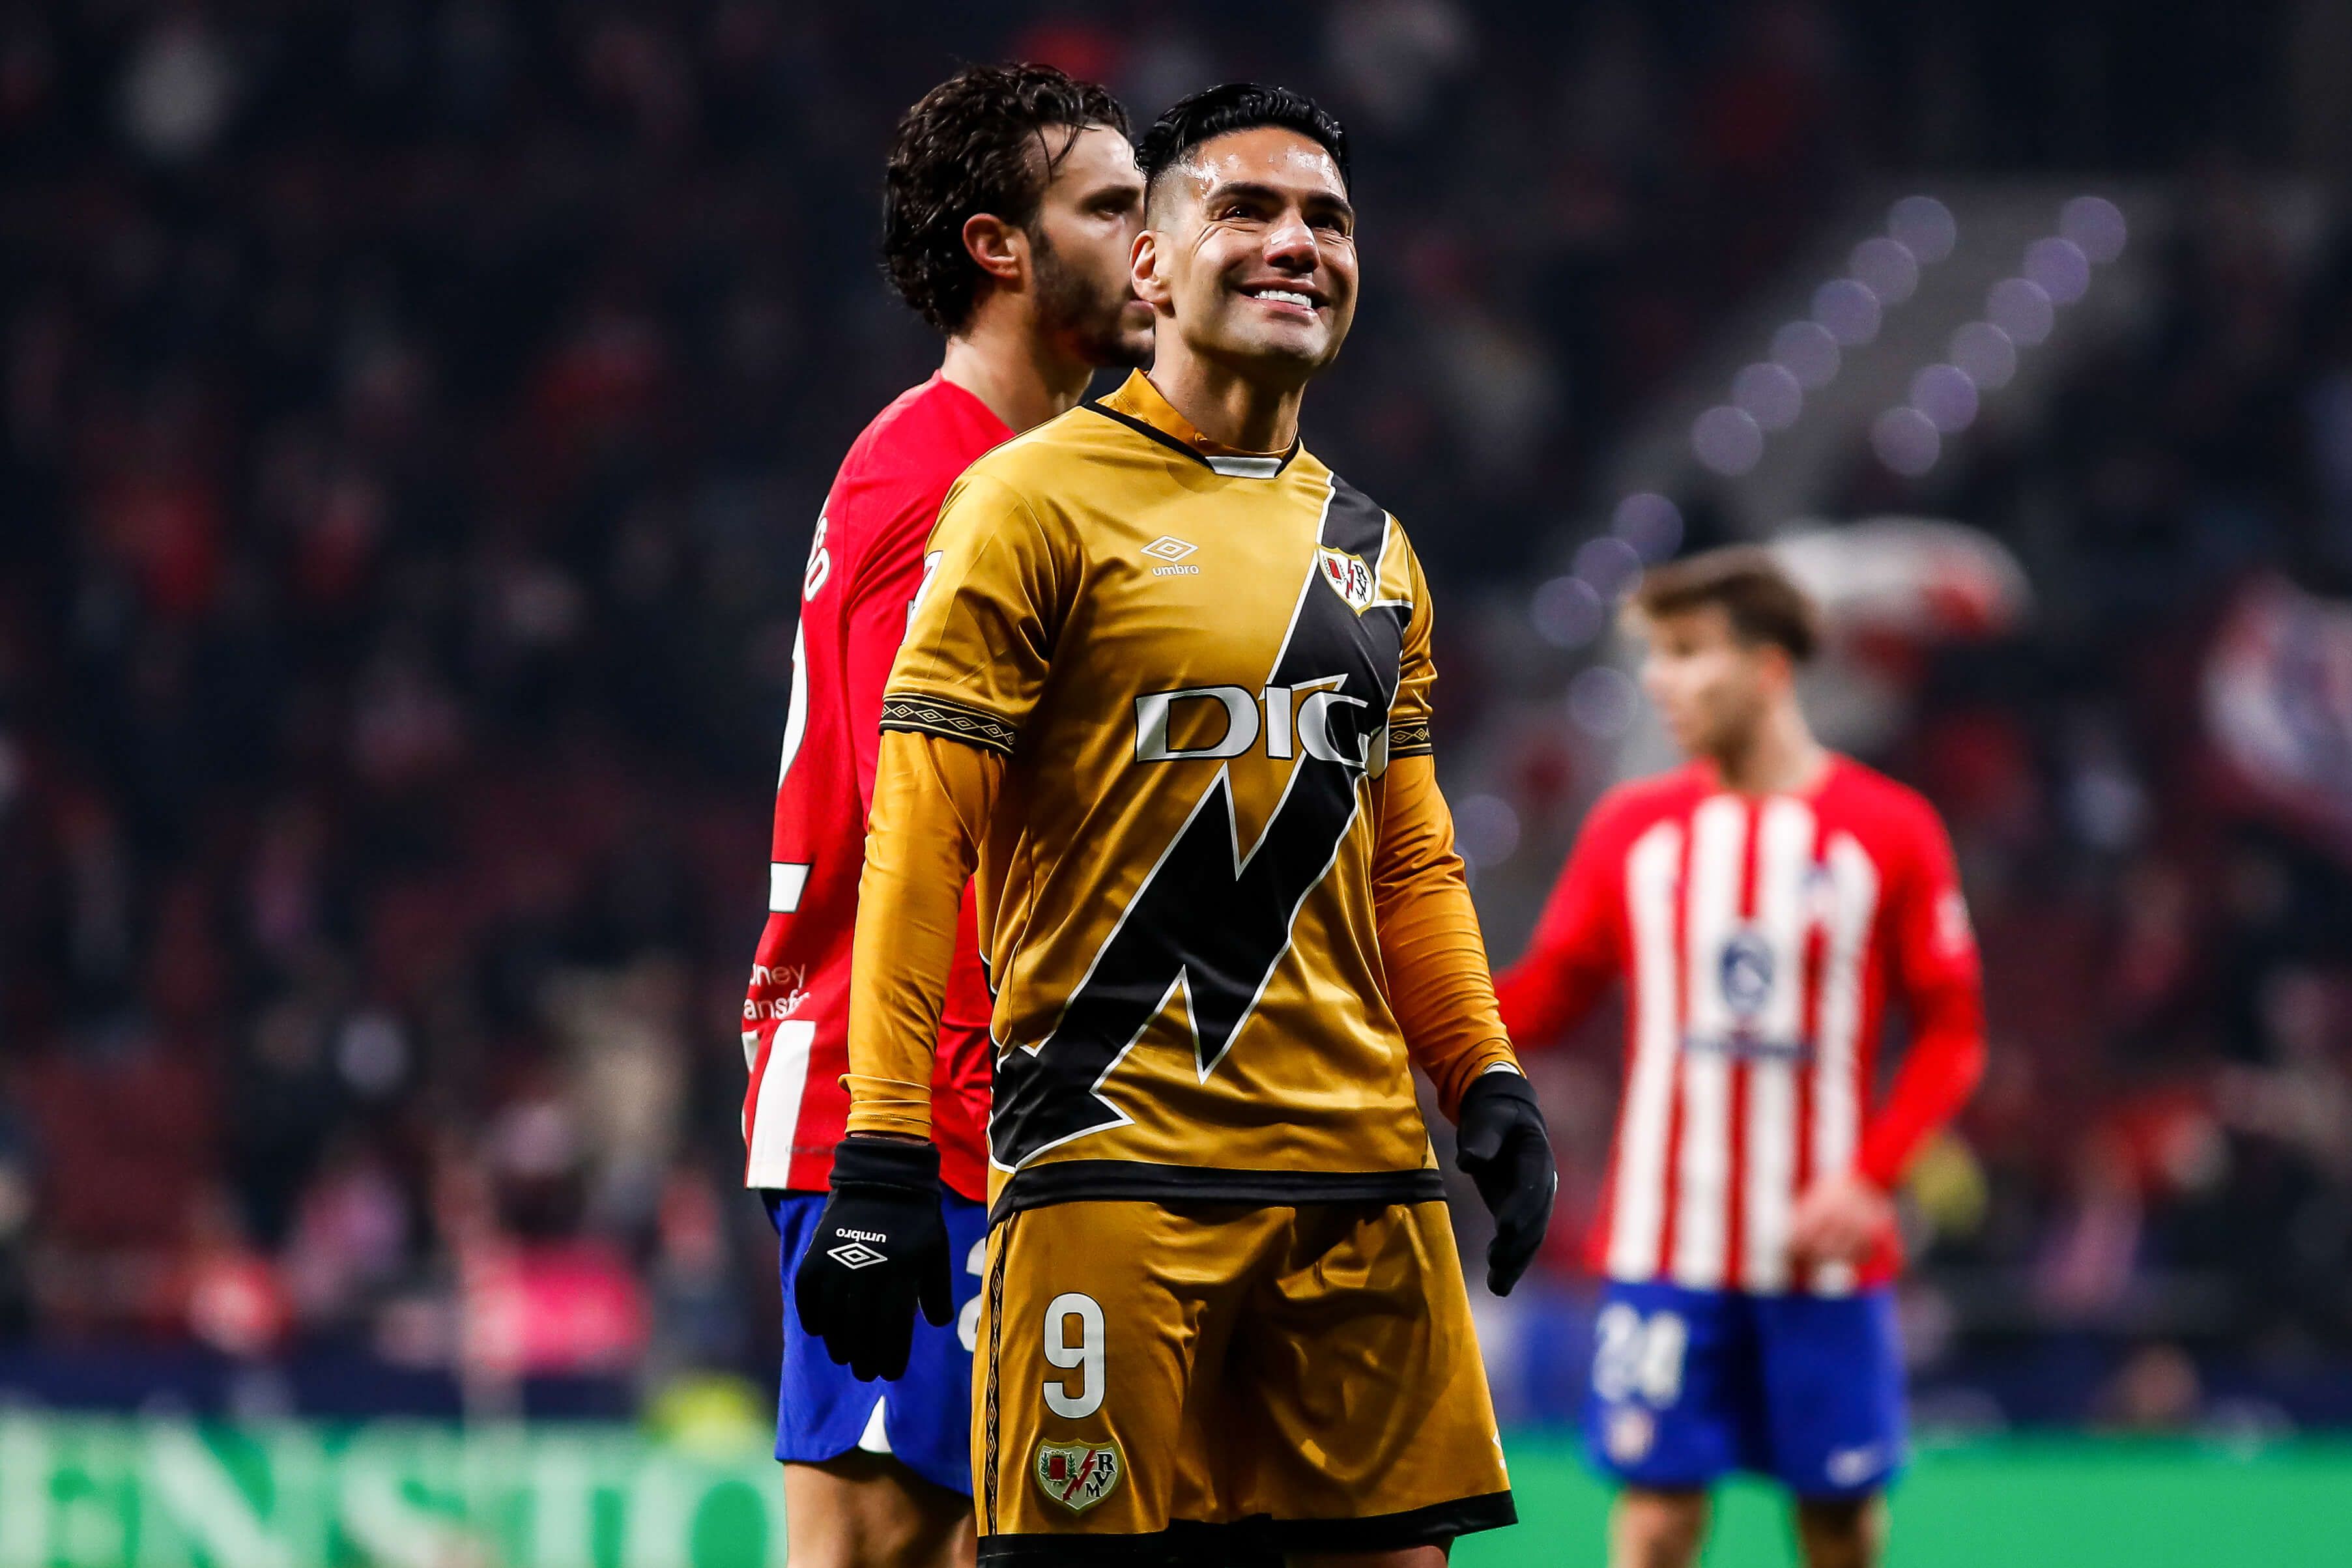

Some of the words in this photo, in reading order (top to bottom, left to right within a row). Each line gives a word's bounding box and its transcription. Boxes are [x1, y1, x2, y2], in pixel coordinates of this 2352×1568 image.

[1152, 563, 1199, 577] umbro
[835, 1228, 887, 1243] umbro
[1043, 1292, 1106, 1419] 9
[1085, 1451, 1117, 1498] RVM
